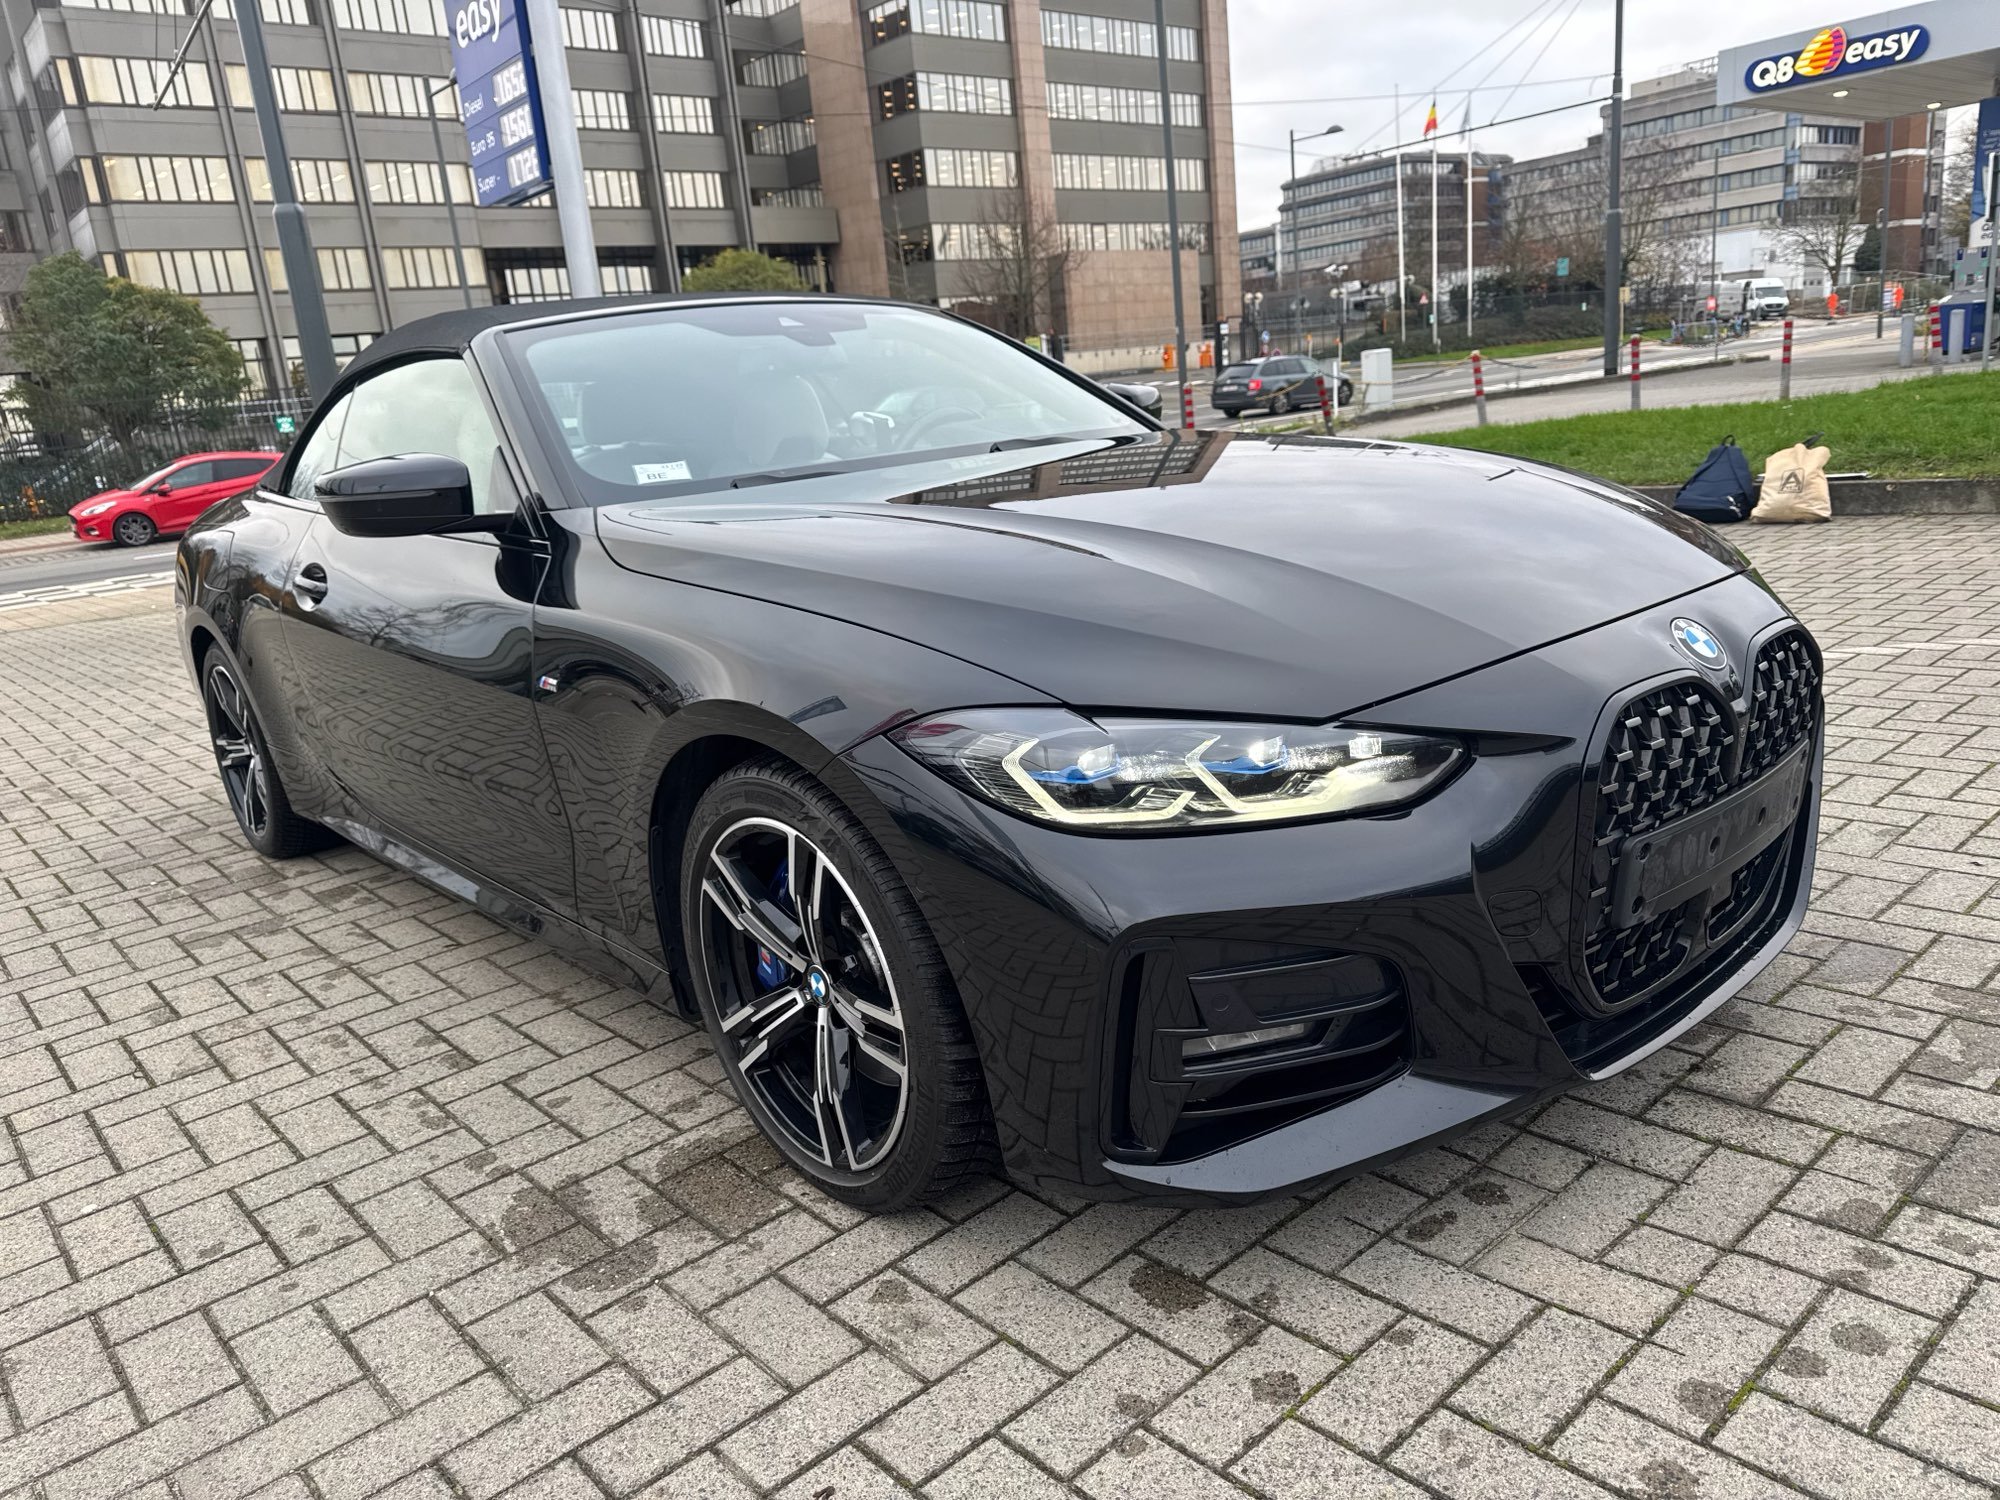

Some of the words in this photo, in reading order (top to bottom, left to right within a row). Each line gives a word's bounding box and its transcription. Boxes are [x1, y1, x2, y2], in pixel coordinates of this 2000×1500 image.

[456, 0, 500, 48] easy
[1752, 55, 1795, 88] Q8
[1845, 29, 1921, 64] easy
[464, 93, 484, 118] Diesel
[471, 139, 486, 157] Euro
[486, 130, 496, 148] 95
[478, 174, 496, 193] Super
